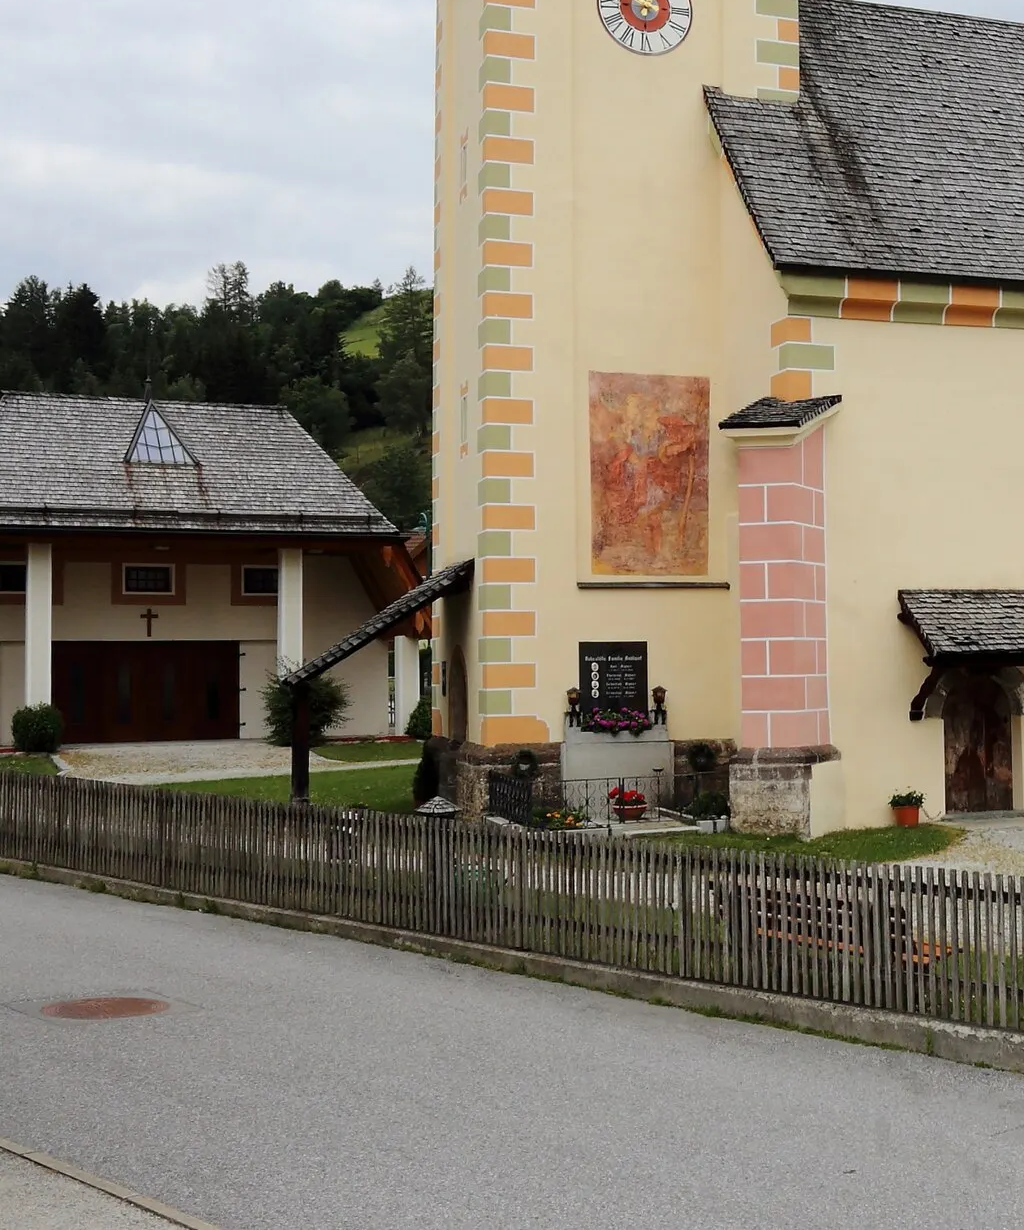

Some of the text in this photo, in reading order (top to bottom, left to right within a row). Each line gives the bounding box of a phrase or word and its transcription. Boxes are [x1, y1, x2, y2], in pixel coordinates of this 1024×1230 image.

[671, 7, 689, 17] III
[619, 26, 635, 47] VII
[641, 33, 652, 51] VI
